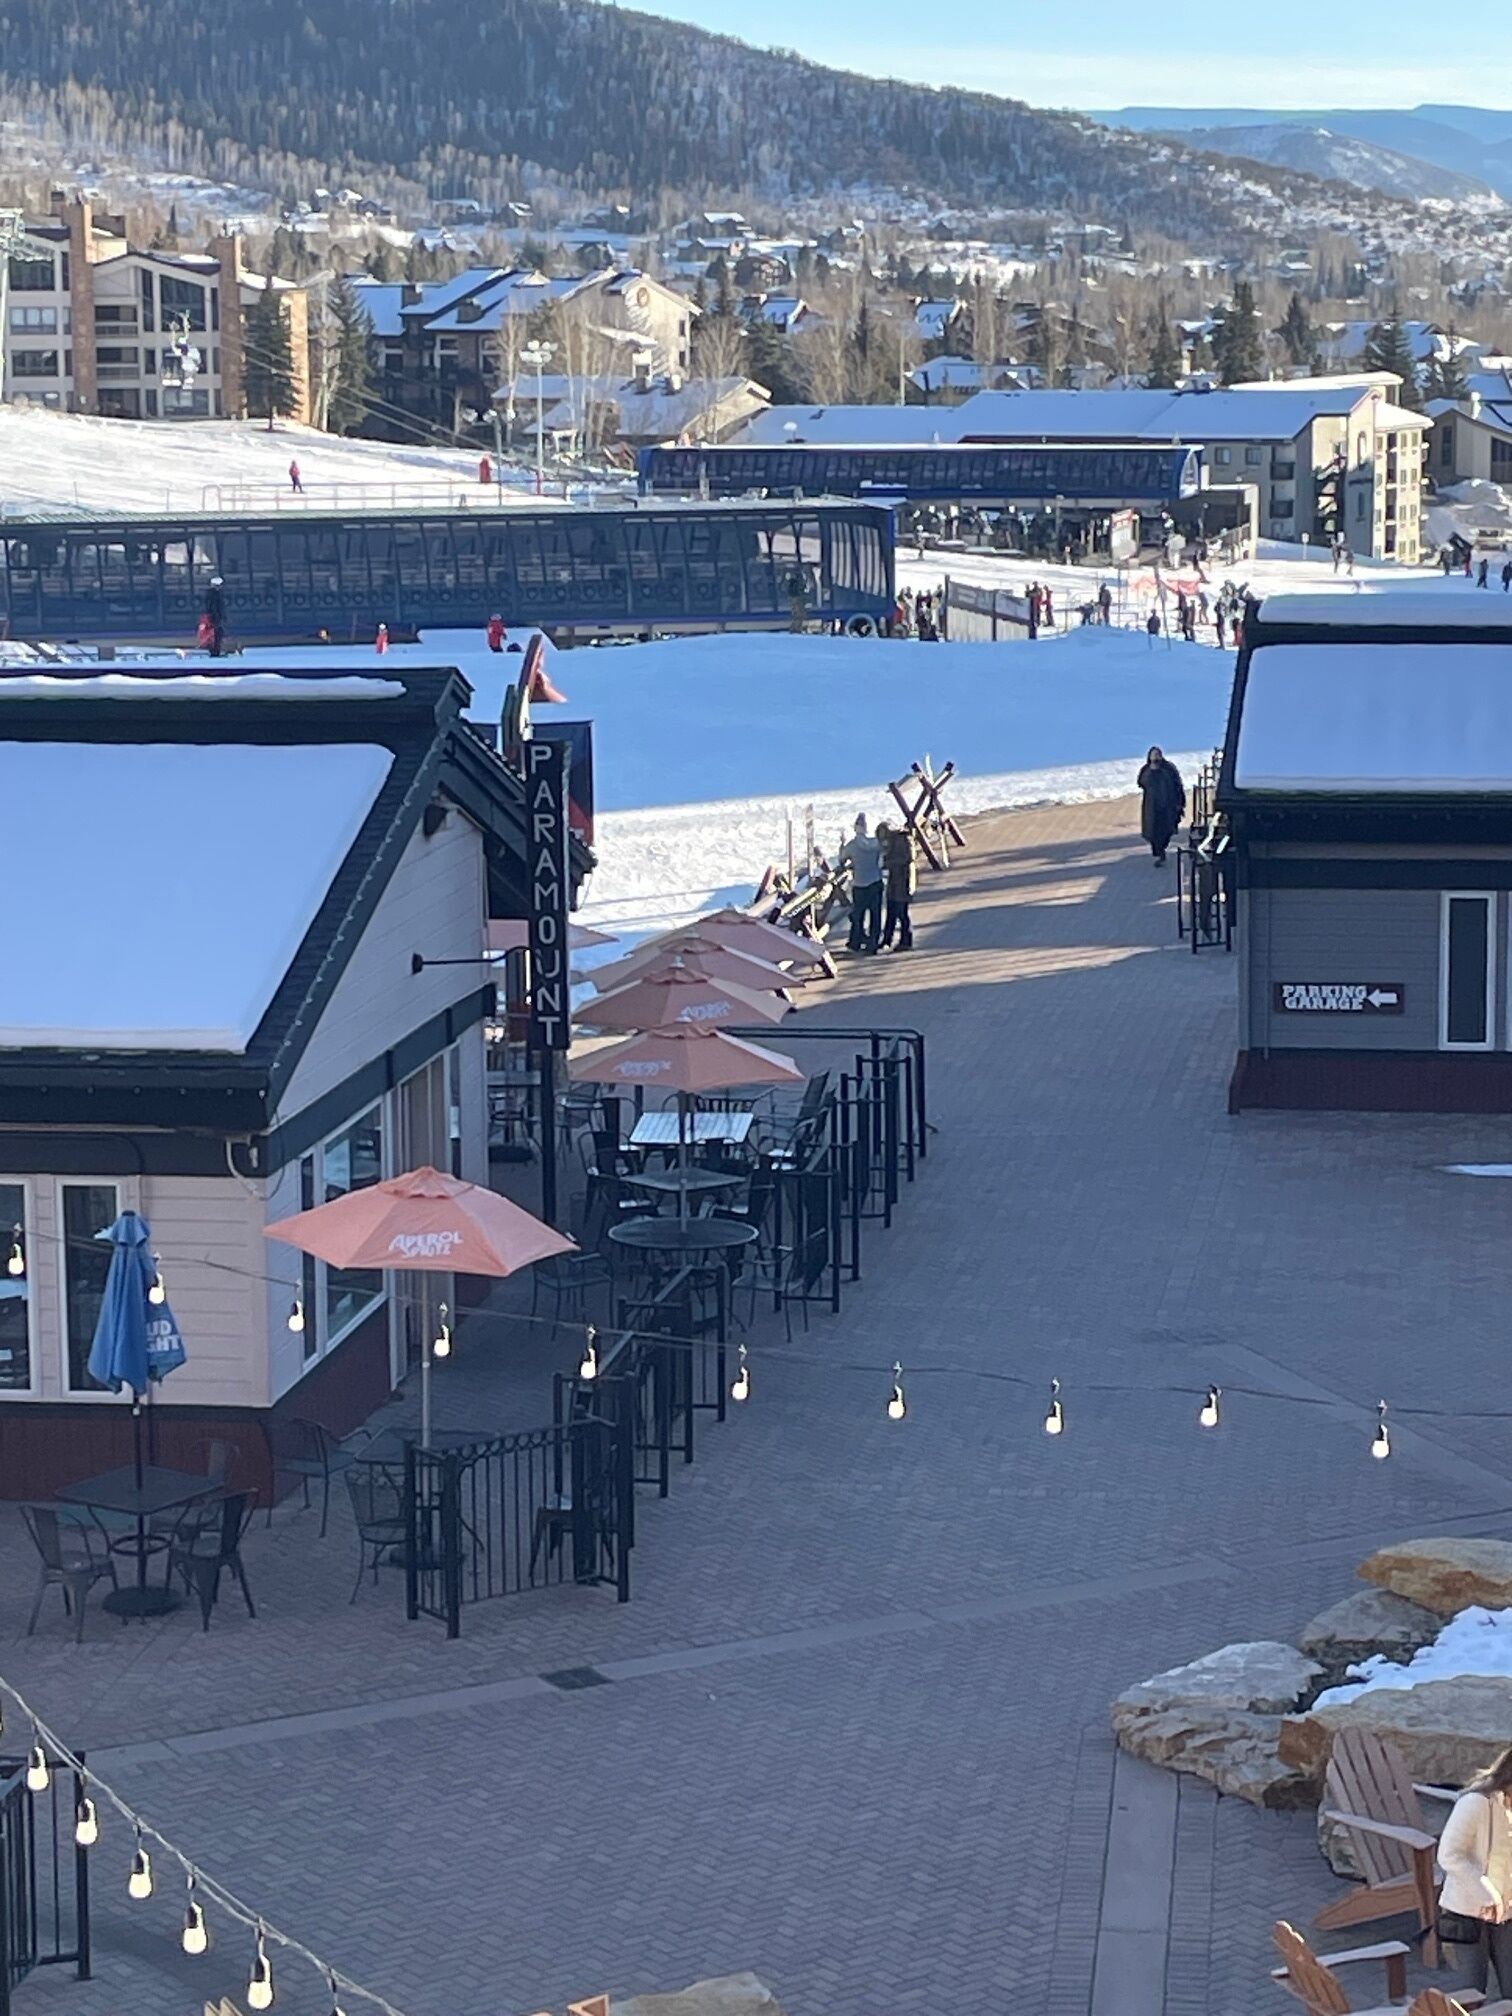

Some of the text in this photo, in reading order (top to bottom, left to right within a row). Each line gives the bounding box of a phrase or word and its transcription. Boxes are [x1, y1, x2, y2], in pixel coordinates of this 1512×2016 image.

[530, 744, 561, 1046] PARAMOUNT
[1282, 985, 1367, 1000] PARKING
[1285, 998, 1364, 1010] GARAGE
[388, 1231, 464, 1251] APEROL
[146, 1320, 172, 1336] UD
